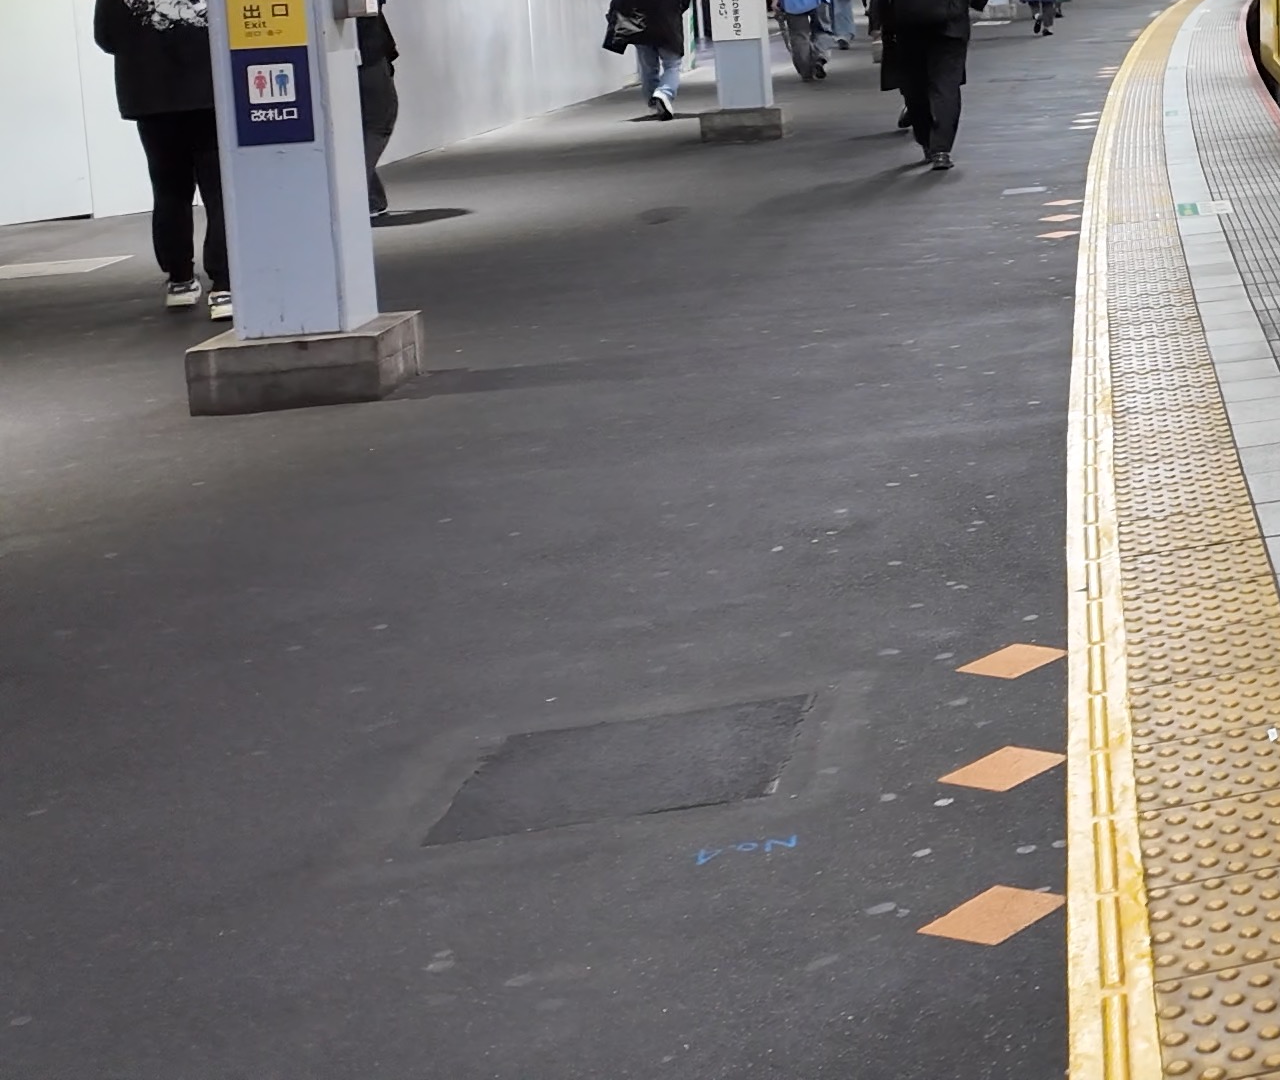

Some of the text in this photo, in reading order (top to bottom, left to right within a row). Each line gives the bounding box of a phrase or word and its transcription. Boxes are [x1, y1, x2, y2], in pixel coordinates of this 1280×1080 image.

[243, 3, 289, 19] 出口
[244, 21, 267, 29] Exit
[251, 107, 299, 122] 改札口
